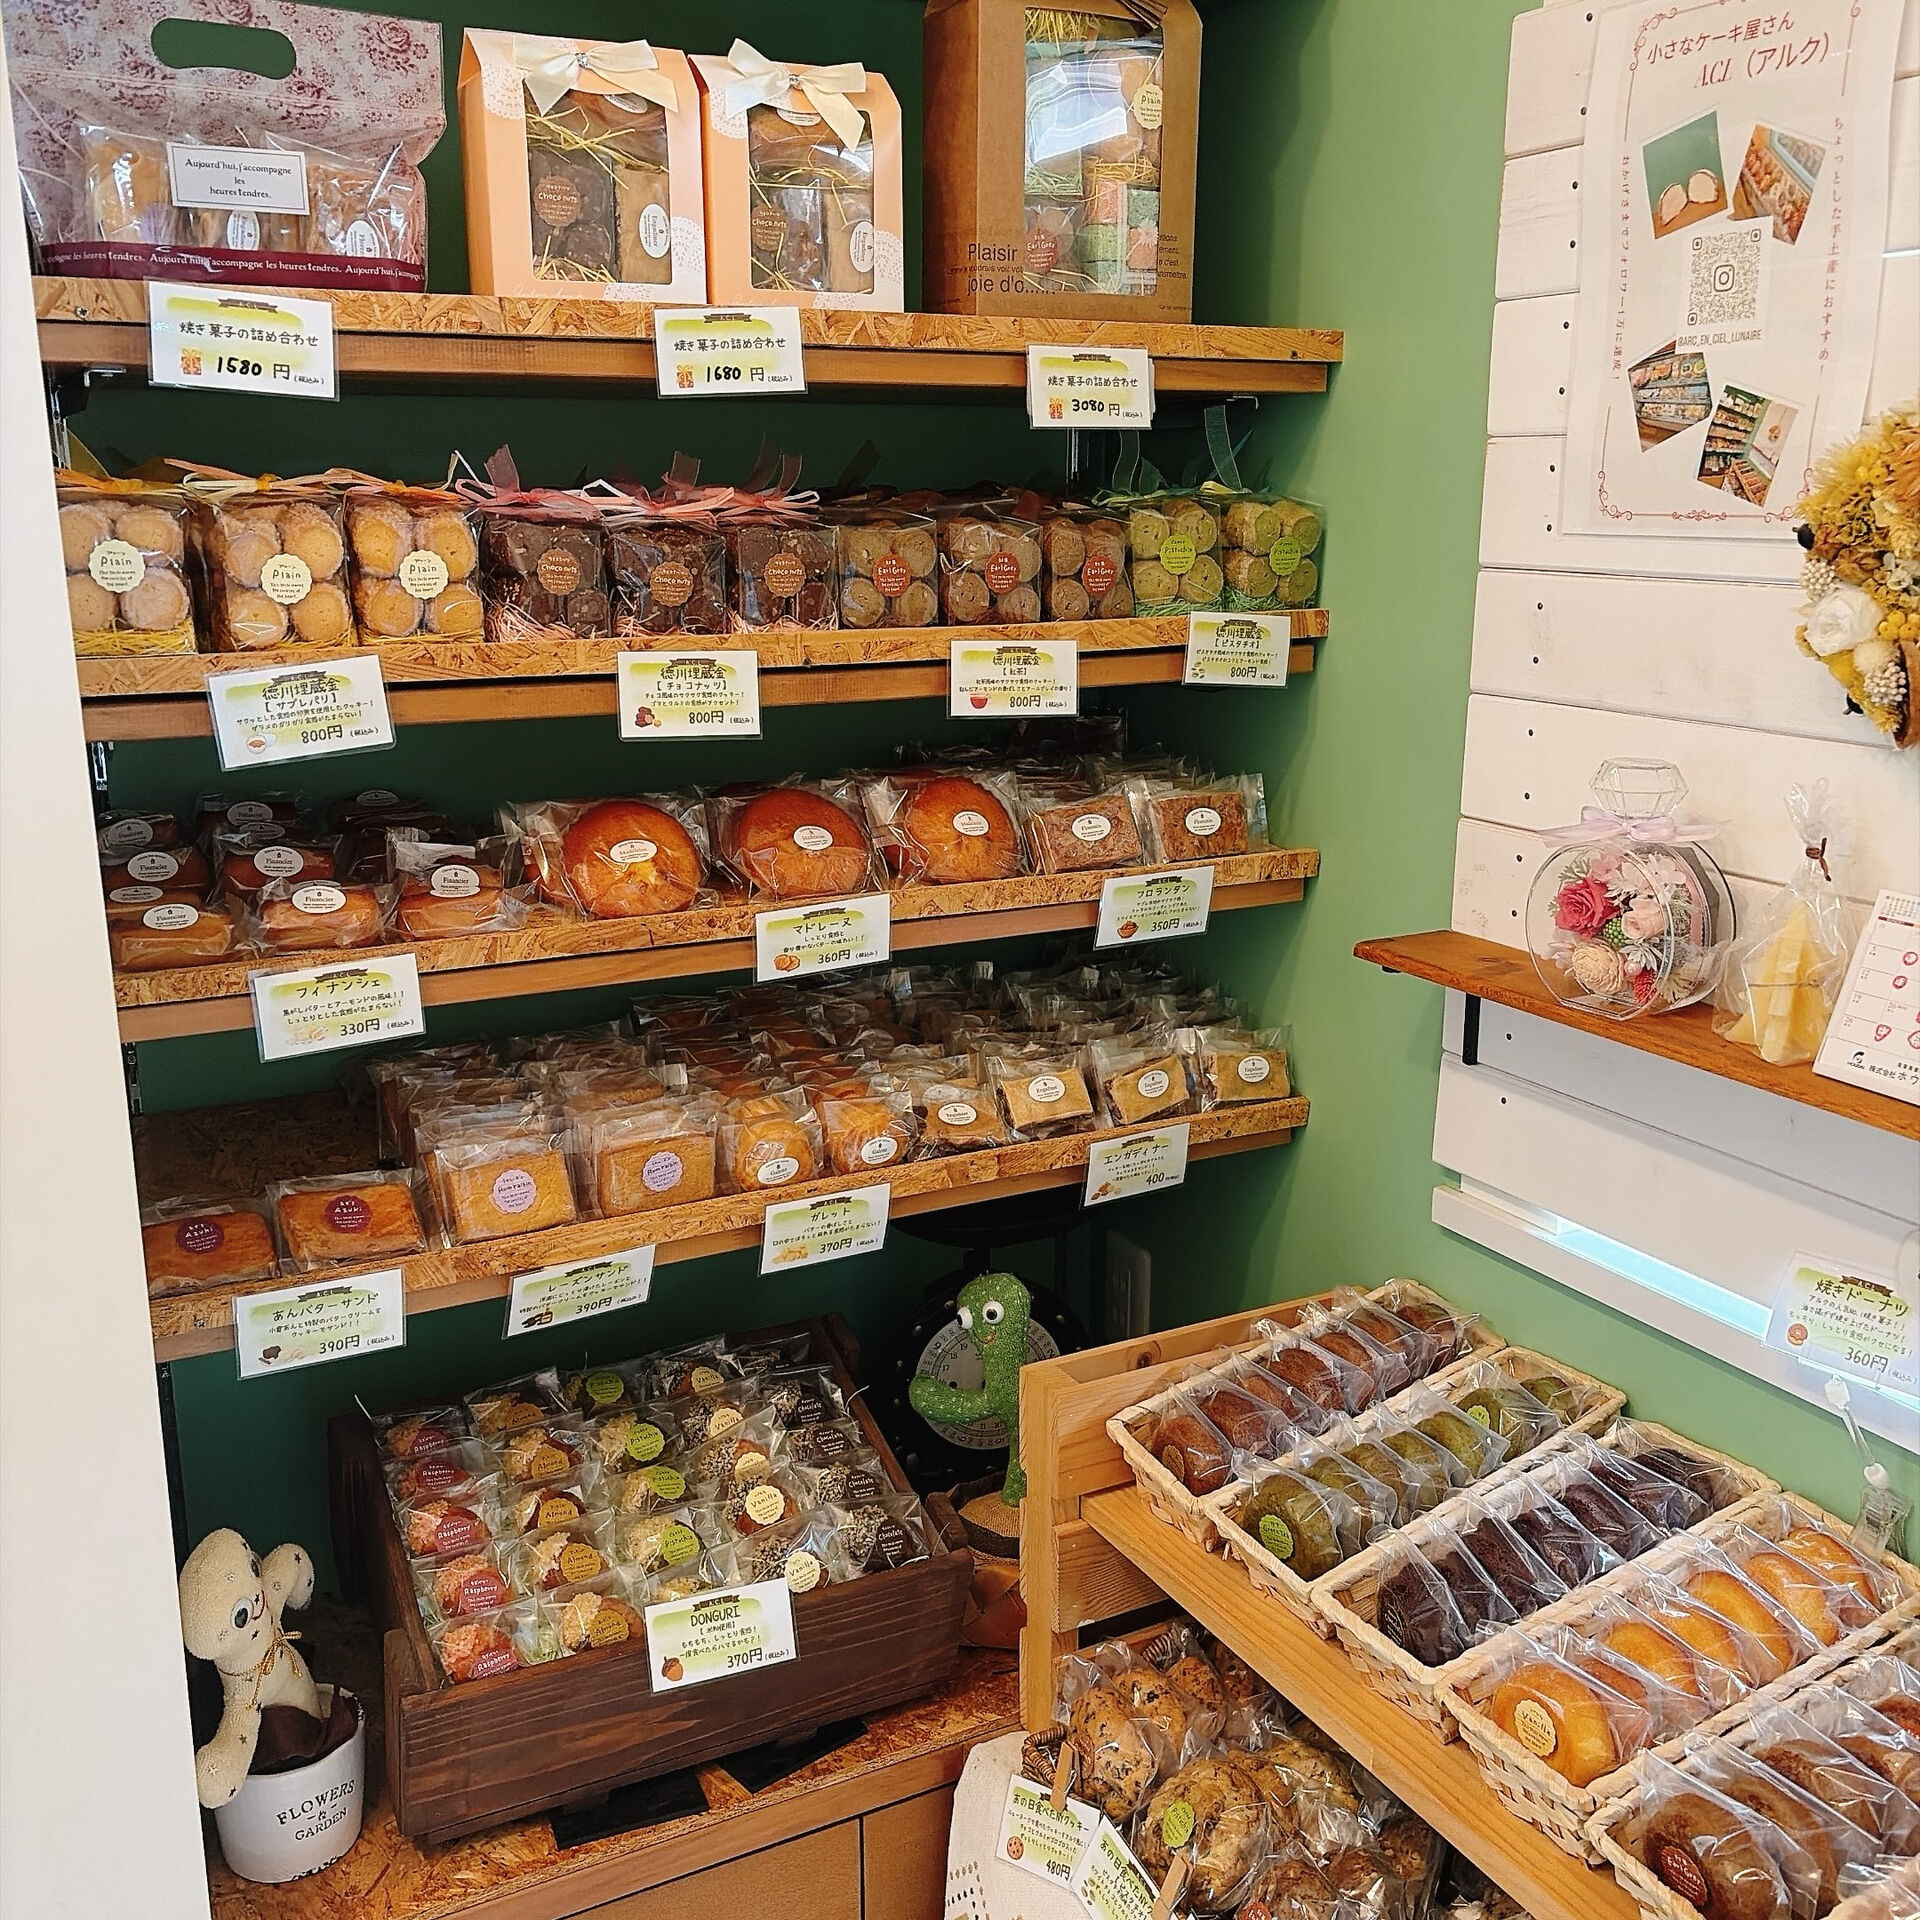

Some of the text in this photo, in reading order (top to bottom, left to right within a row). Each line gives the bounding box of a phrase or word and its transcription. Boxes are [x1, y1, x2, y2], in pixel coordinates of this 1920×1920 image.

[1648, 12, 1794, 64] 小さなケーキ屋さん
[1747, 33, 1829, 77] （アルク）
[1141, 94, 1161, 106] Plain
[235, 176, 245, 185] les
[538, 192, 561, 204] Choco
[752, 219, 773, 229] Choco
[968, 243, 1018, 262] Plaisir
[265, 260, 278, 269] les
[968, 275, 994, 296] joie
[180, 321, 319, 347] 焼き菓子の詰め合わせ
[1677, 329, 1762, 347] @ARC_EN_CIEL_LUNAIRE
[674, 336, 786, 352] 焼き菓子の詰め合わせ
[1047, 375, 1138, 388] 焼き菓子の詰め合わせ
[101, 555, 132, 568] Plain
[409, 563, 437, 576] Plain
[273, 570, 301, 582] Plain
[661, 667, 727, 680] 徳川埋蔵金
[1230, 666, 1257, 678] 800円
[262, 677, 340, 701] 徳川埋蔵金
[1009, 695, 1041, 708] 800円
[688, 710, 724, 724] 800円
[301, 724, 343, 744] 800円
[1137, 884, 1190, 898] フロランタン
[156, 912, 187, 922] Financier
[1151, 918, 1180, 932] 350円
[793, 917, 852, 935] マドレーヌ
[818, 949, 850, 964] 360円
[296, 979, 381, 998] フィナンシェ
[340, 1018, 380, 1036] 330円
[1104, 1145, 1169, 1164] エンガディナー
[1146, 1172, 1165, 1185] 400
[334, 1205, 363, 1214] Azuki
[811, 1207, 850, 1222] ガレット
[820, 1237, 852, 1254] 370円
[549, 1266, 628, 1292] レーズンサンド
[576, 1297, 612, 1314] 390円
[1815, 1279, 1908, 1317] 焼きドーナツ
[273, 1293, 379, 1321] あんバターサンド
[319, 1335, 360, 1354] 390円
[1844, 1347, 1889, 1373] 360円
[750, 1491, 778, 1508] Vanilla
[437, 1524, 471, 1538] Raspberry
[788, 1560, 813, 1576] Vanilla
[464, 1584, 498, 1596] Raspberry
[691, 1606, 741, 1627] DONGURI
[477, 1653, 510, 1672] Raspberry
[727, 1648, 763, 1669] 370円
[276, 1779, 355, 1826] FLOWERS
[295, 1807, 347, 1841] GARDEN
[1046, 1860, 1070, 1881] 480円
